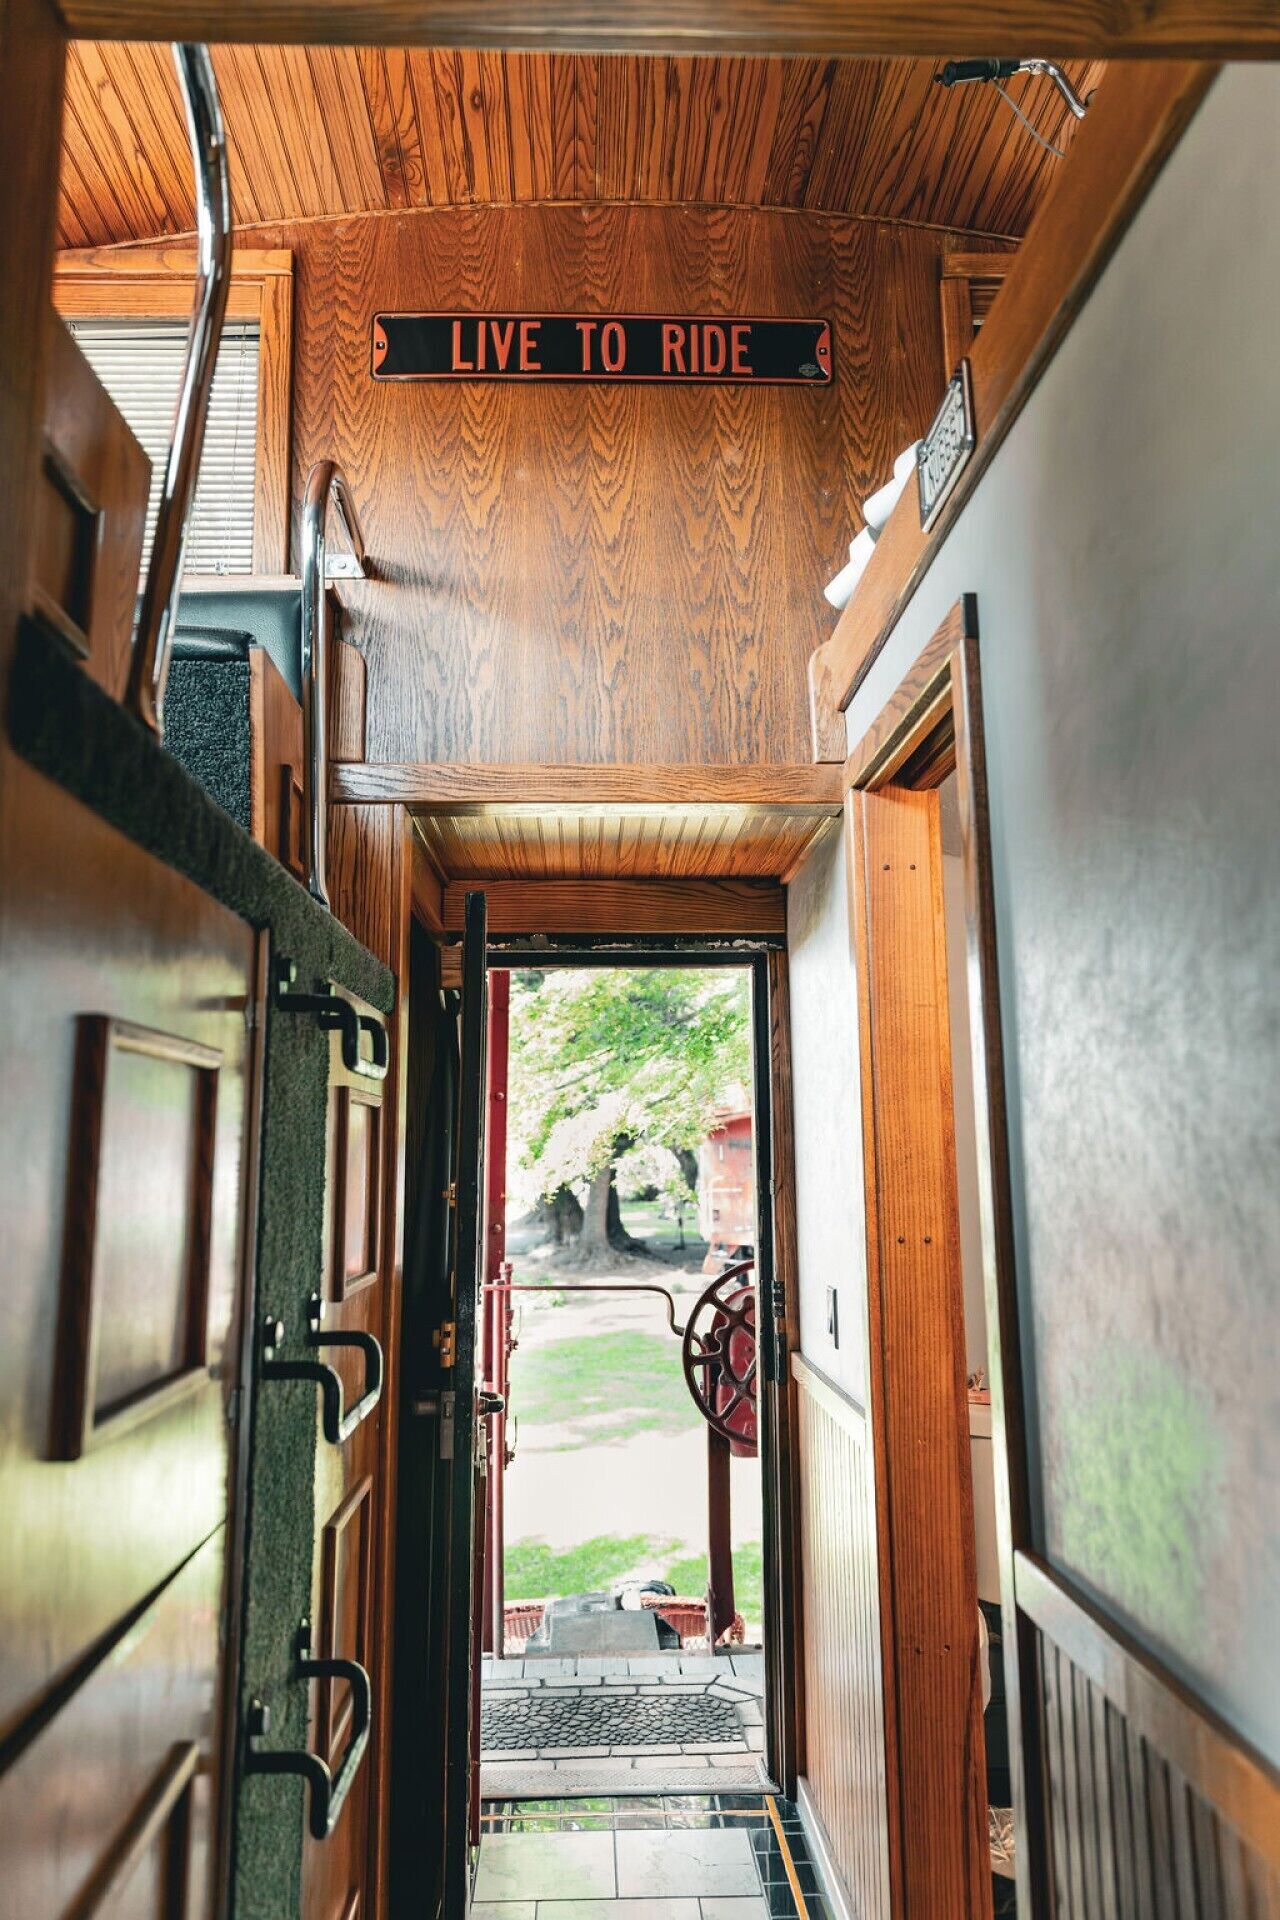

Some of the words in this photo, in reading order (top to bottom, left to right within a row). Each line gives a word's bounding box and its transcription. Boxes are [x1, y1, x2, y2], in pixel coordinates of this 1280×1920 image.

[452, 321, 541, 371] LIVE
[576, 322, 627, 372] TO
[662, 323, 753, 374] RIDE
